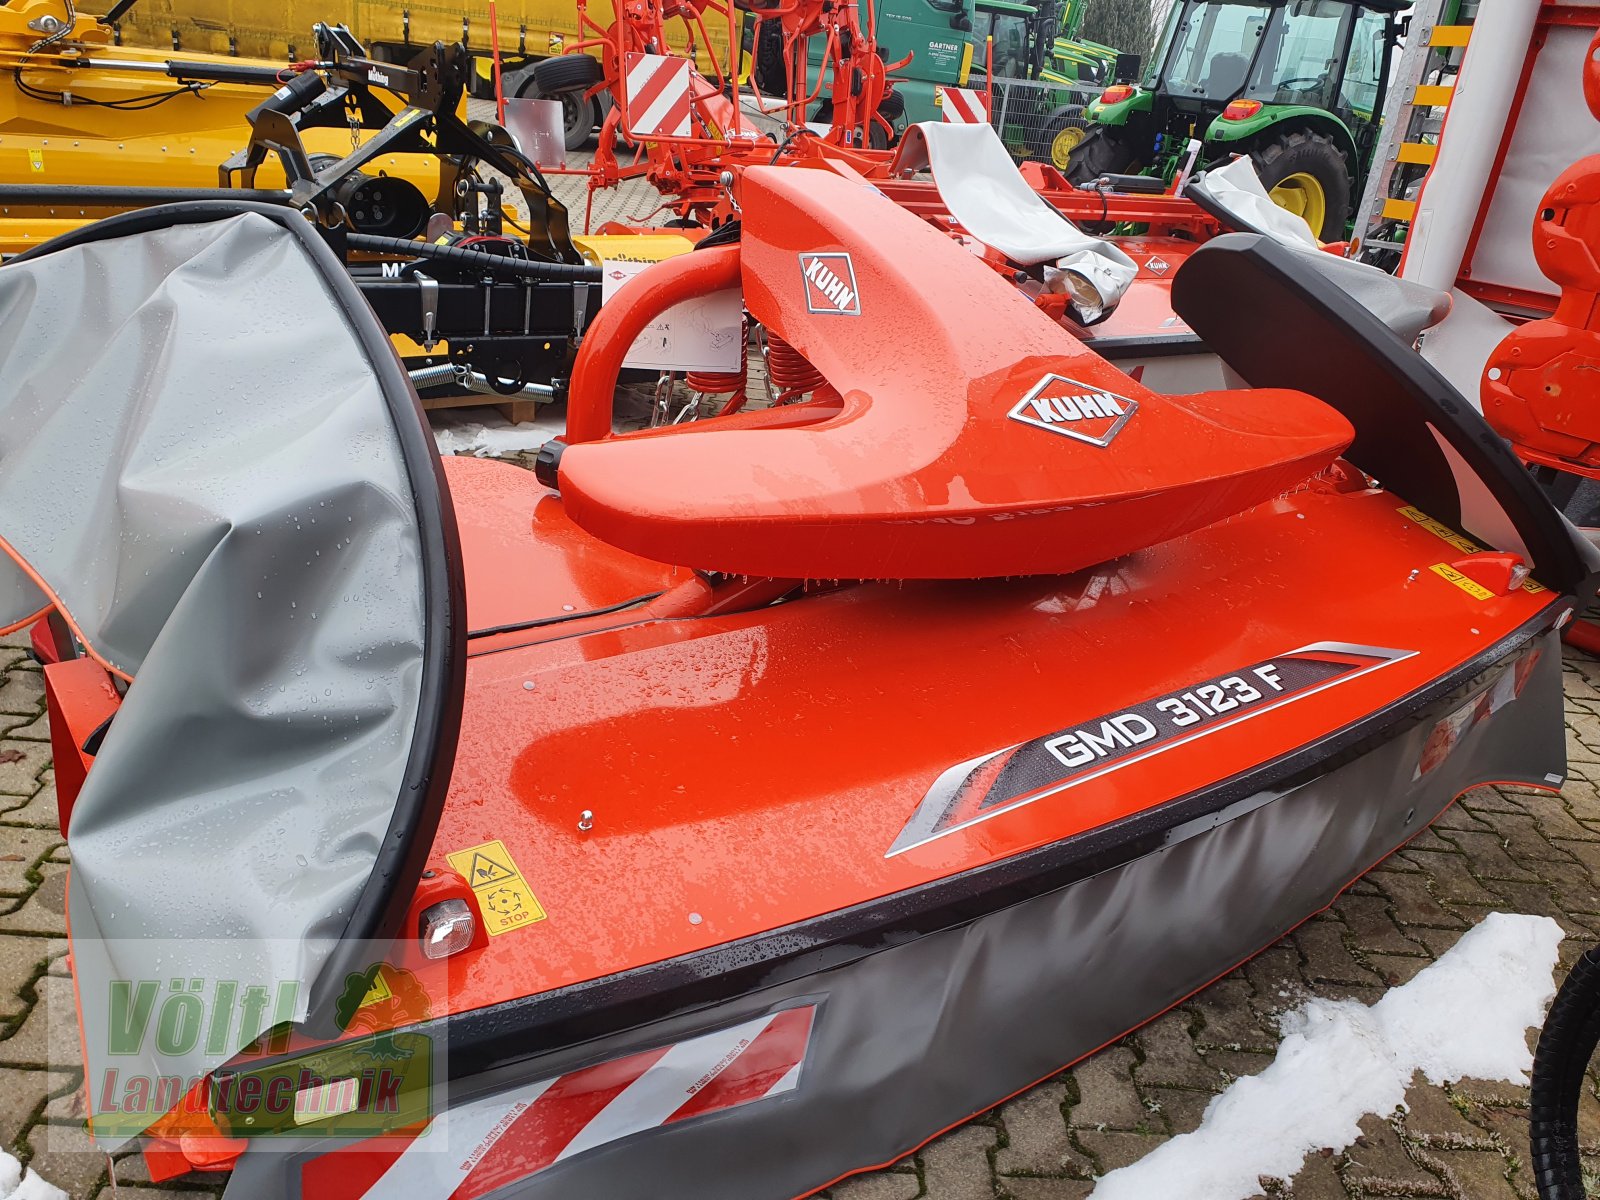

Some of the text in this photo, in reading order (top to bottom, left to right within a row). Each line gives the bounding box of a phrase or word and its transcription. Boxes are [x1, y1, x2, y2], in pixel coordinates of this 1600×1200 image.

[929, 41, 958, 50] GARTNER
[805, 256, 854, 311] KUHN
[1030, 393, 1125, 423] KUHN
[1044, 664, 1284, 768] GMD 3123 F
[500, 911, 529, 926] STOP
